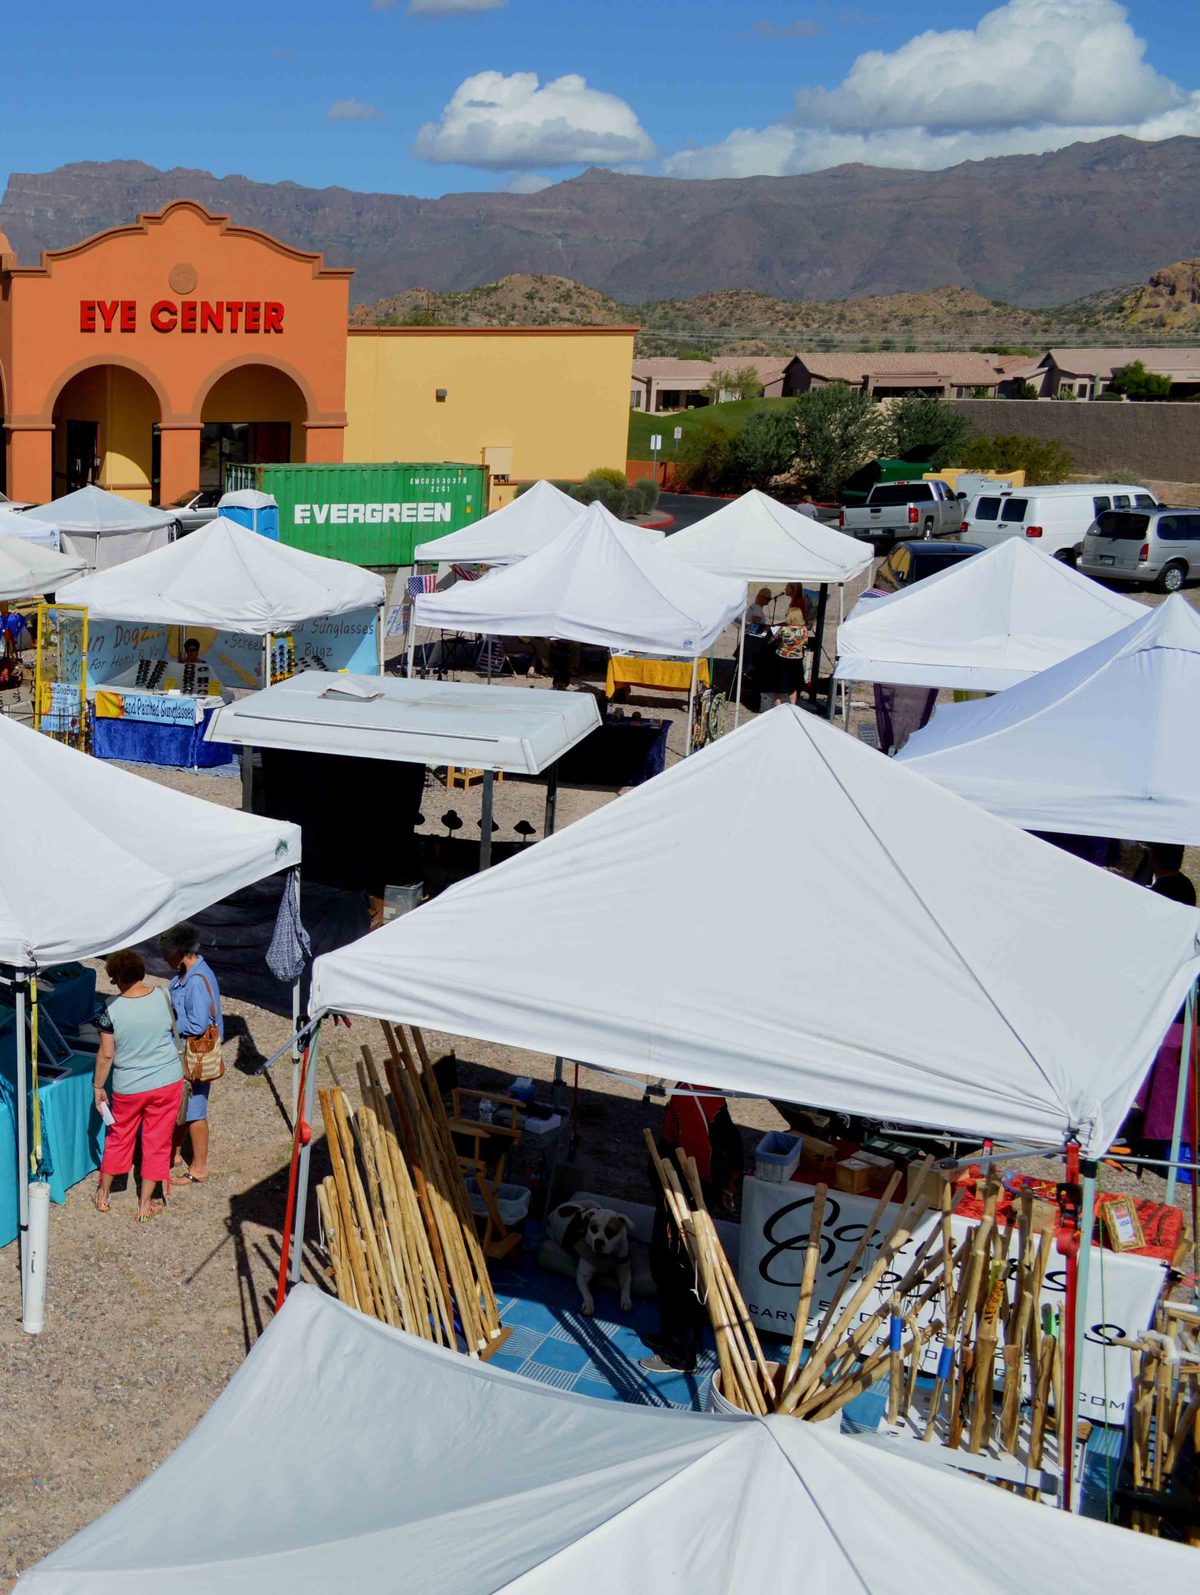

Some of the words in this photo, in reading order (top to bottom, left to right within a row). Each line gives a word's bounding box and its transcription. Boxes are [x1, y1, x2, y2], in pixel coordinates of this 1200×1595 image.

[80, 300, 136, 333] EYE
[150, 300, 284, 333] CENTER
[294, 503, 452, 524] EVERGREEN
[310, 617, 374, 639] Sunglasses
[67, 628, 104, 655] Sn
[304, 642, 334, 660] Bugz
[137, 698, 160, 717] Painted
[160, 701, 195, 724] Sunglasses
